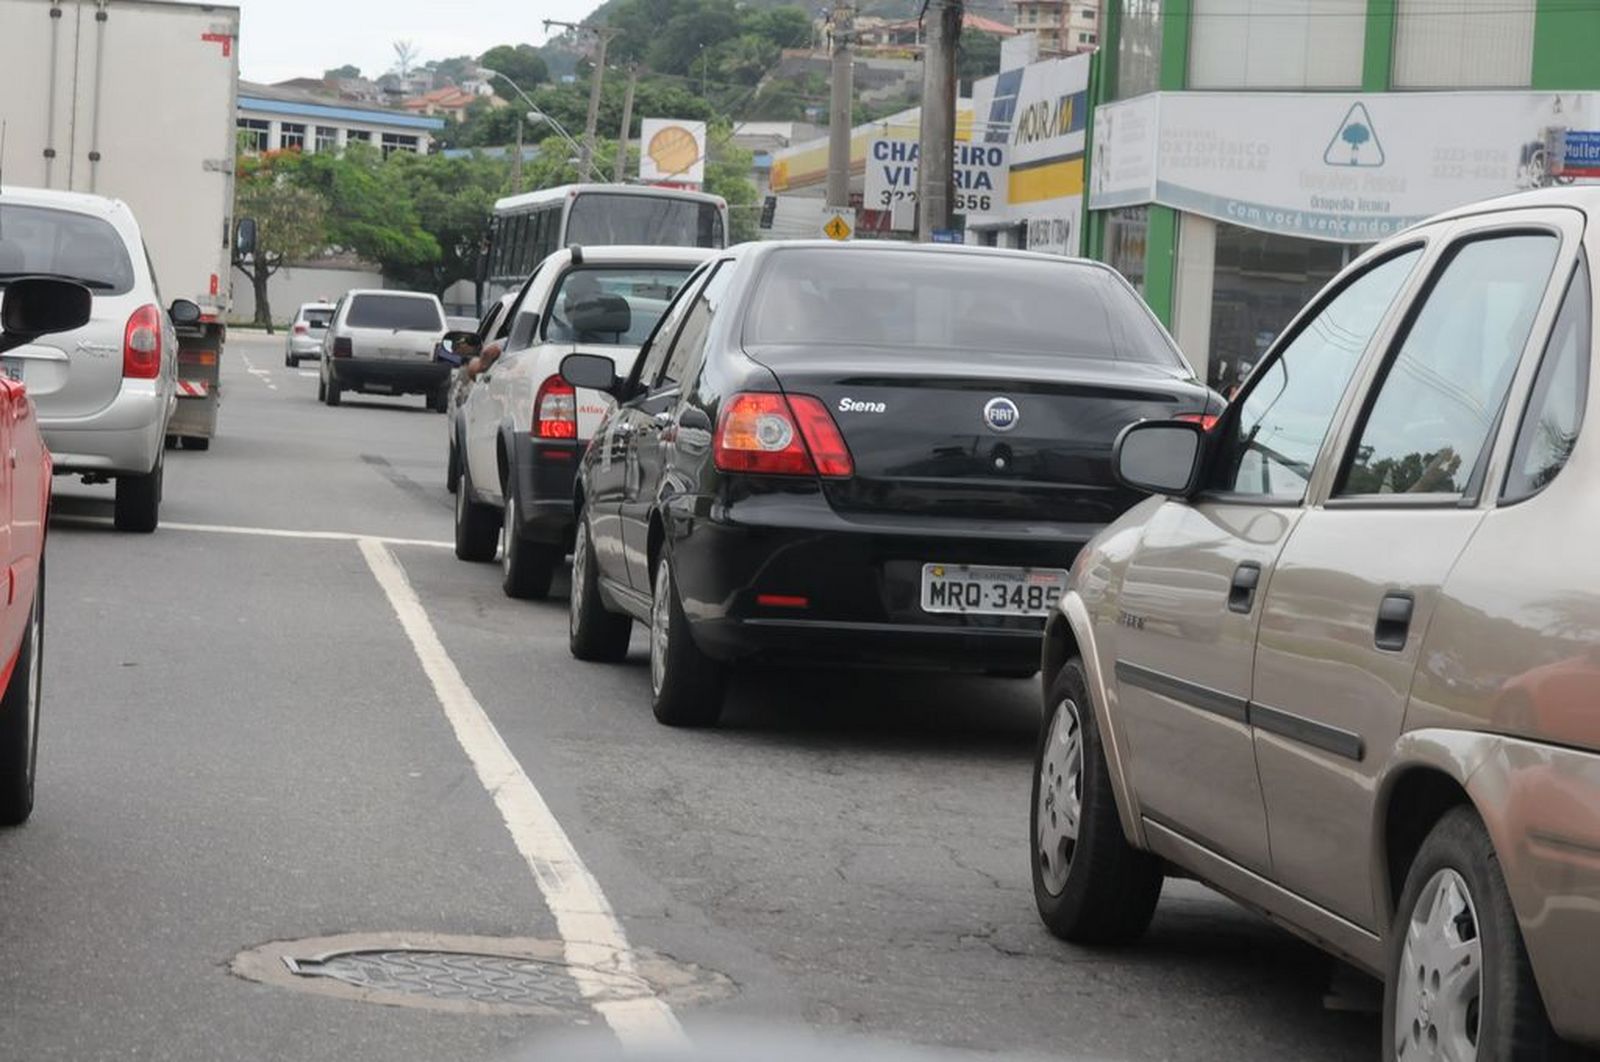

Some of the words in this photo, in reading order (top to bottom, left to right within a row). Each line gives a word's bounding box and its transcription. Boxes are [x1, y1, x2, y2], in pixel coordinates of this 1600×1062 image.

[873, 141, 1003, 167] CHAEIRO
[1309, 217, 1390, 232] vencendo
[838, 397, 887, 413] Siena
[989, 407, 1014, 422] FIAT
